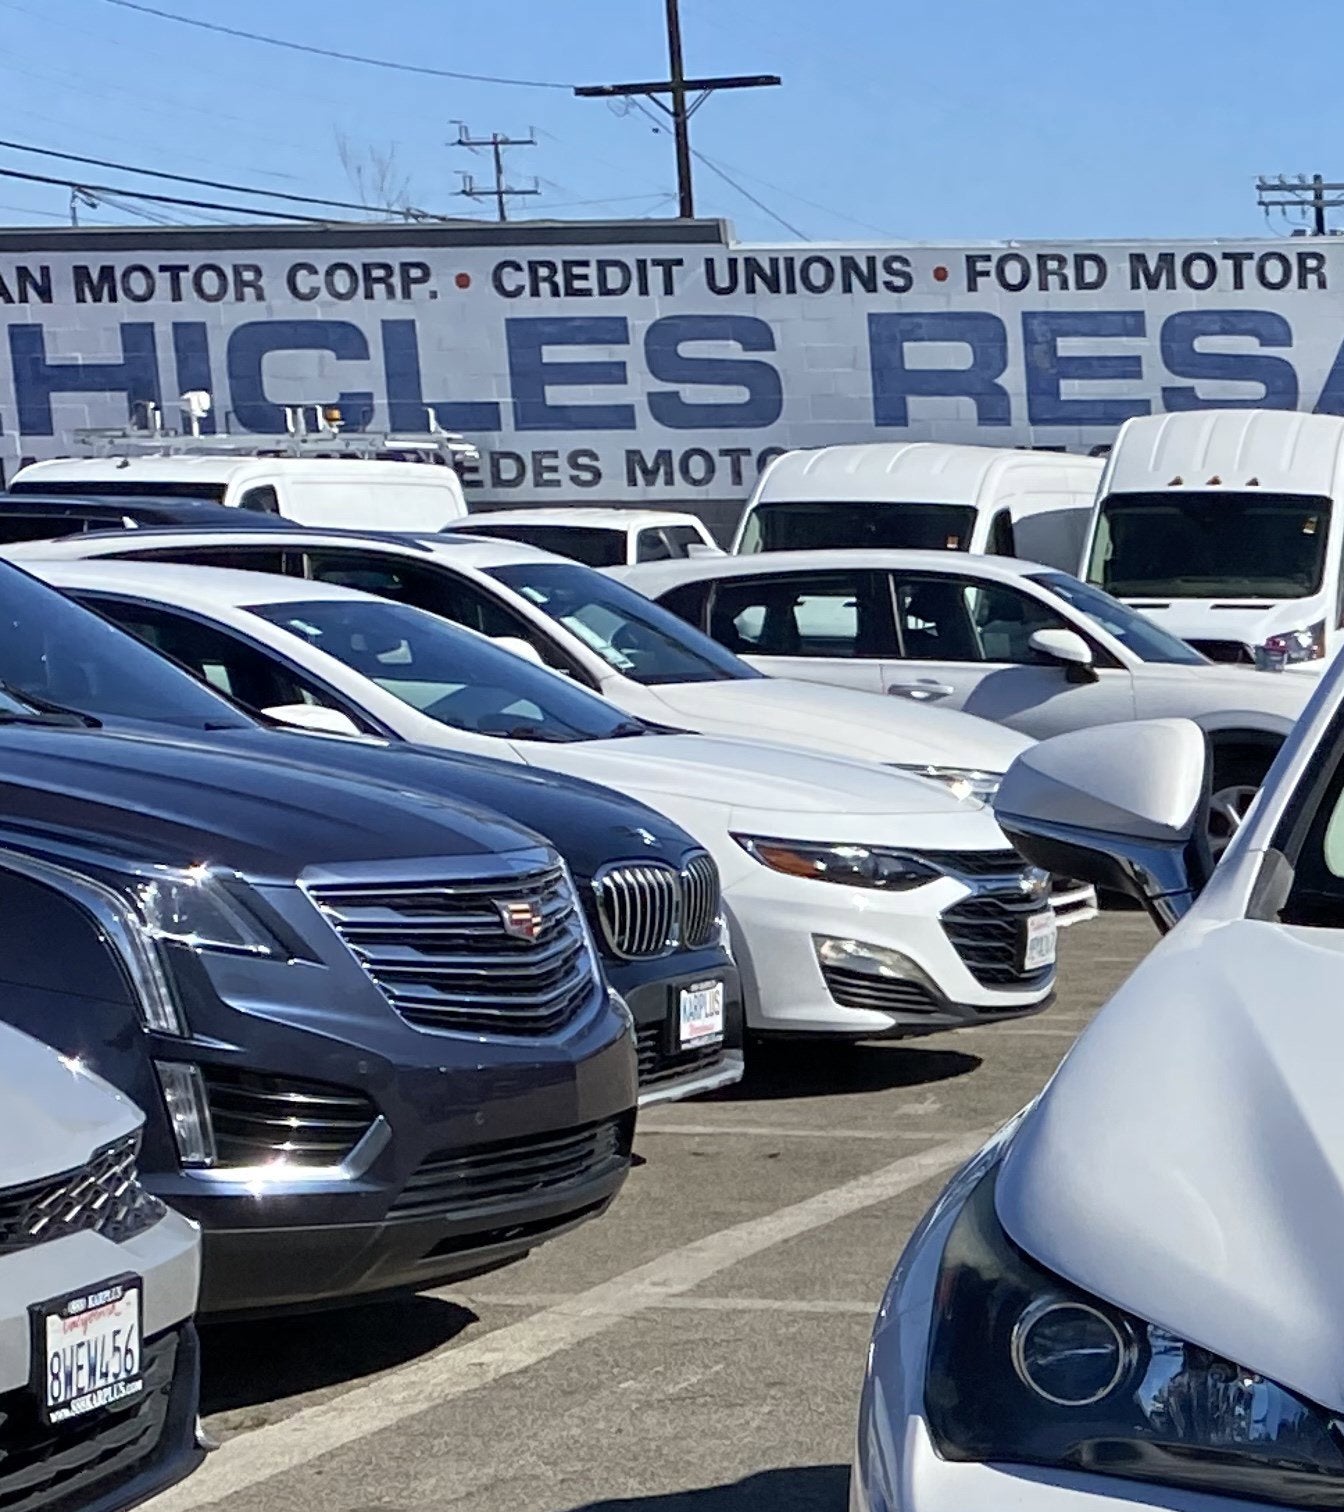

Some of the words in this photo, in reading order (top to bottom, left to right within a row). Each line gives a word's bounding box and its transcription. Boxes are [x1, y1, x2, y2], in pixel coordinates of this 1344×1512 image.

[72, 262, 264, 304] MOTOR
[285, 260, 438, 301] CORP.
[491, 257, 684, 299] CREDIT
[704, 253, 915, 297] UNIONS
[965, 251, 1108, 294] FORD
[1130, 249, 1328, 293] MOTOR
[0, 313, 784, 437] HICLES
